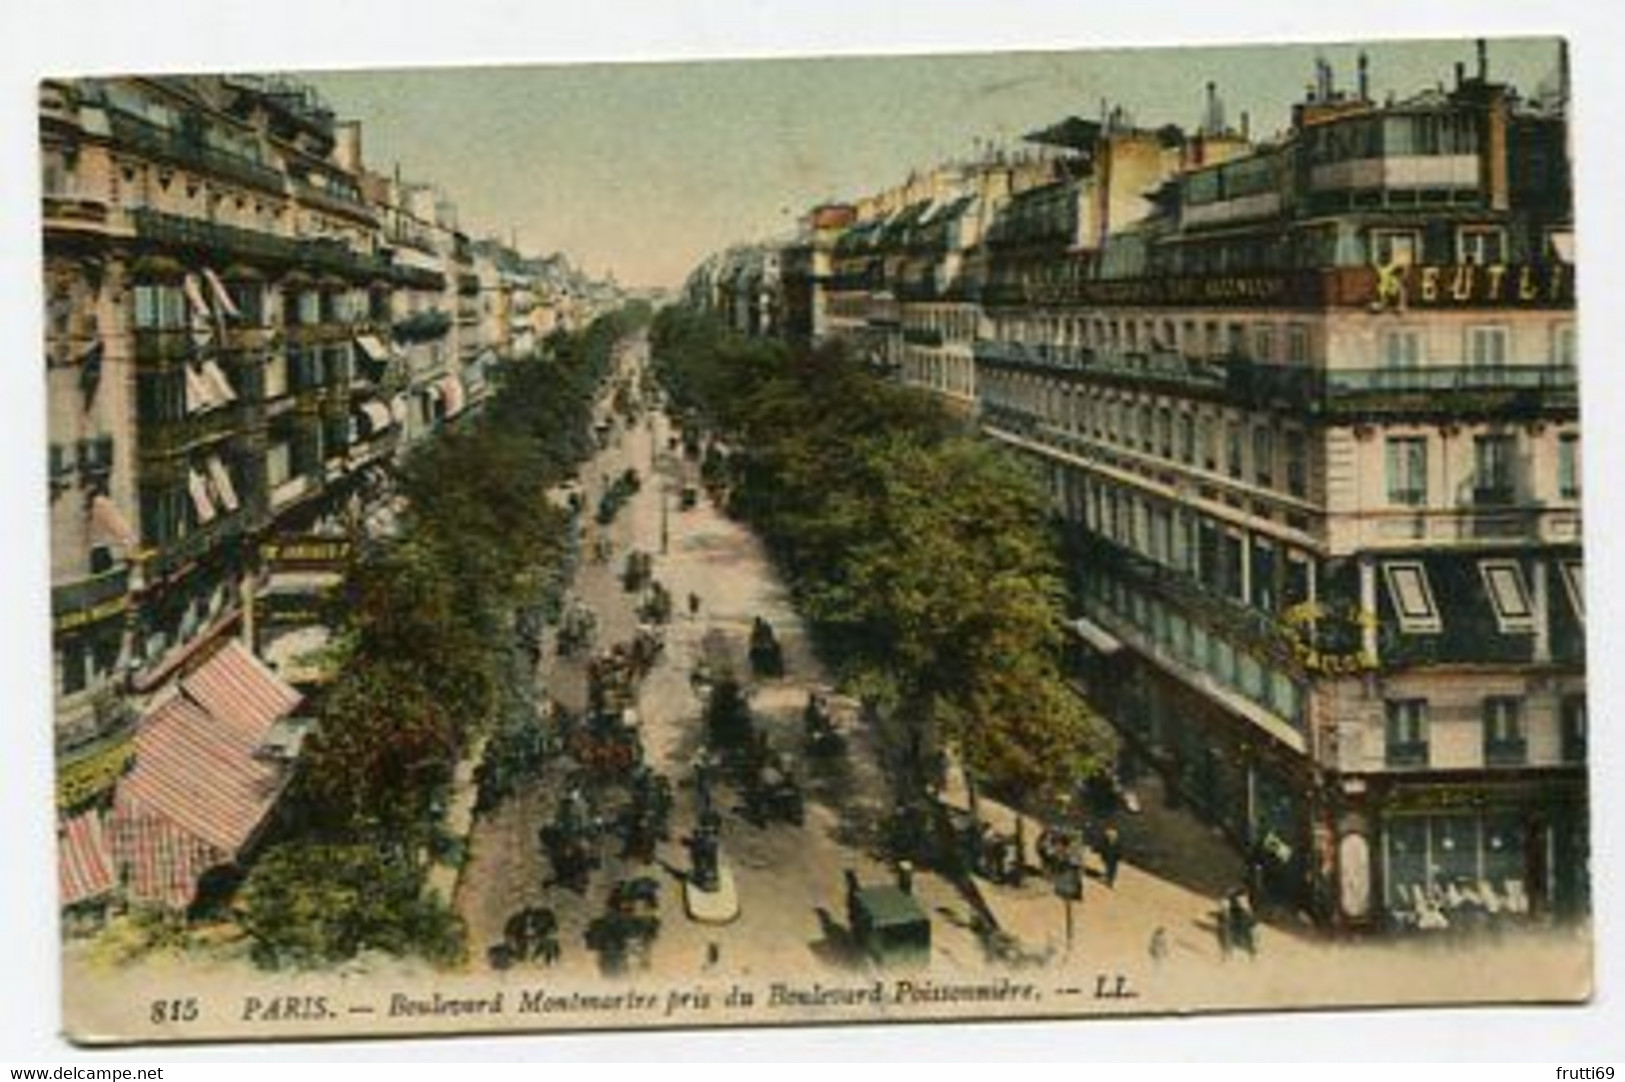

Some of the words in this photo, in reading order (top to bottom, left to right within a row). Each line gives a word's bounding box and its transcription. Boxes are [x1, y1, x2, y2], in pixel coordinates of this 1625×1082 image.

[150, 999, 199, 1024] 815
[241, 996, 337, 1022] PARIS.
[388, 992, 504, 1018] Boulevard
[664, 987, 710, 1017] pris
[724, 983, 754, 1008] du
